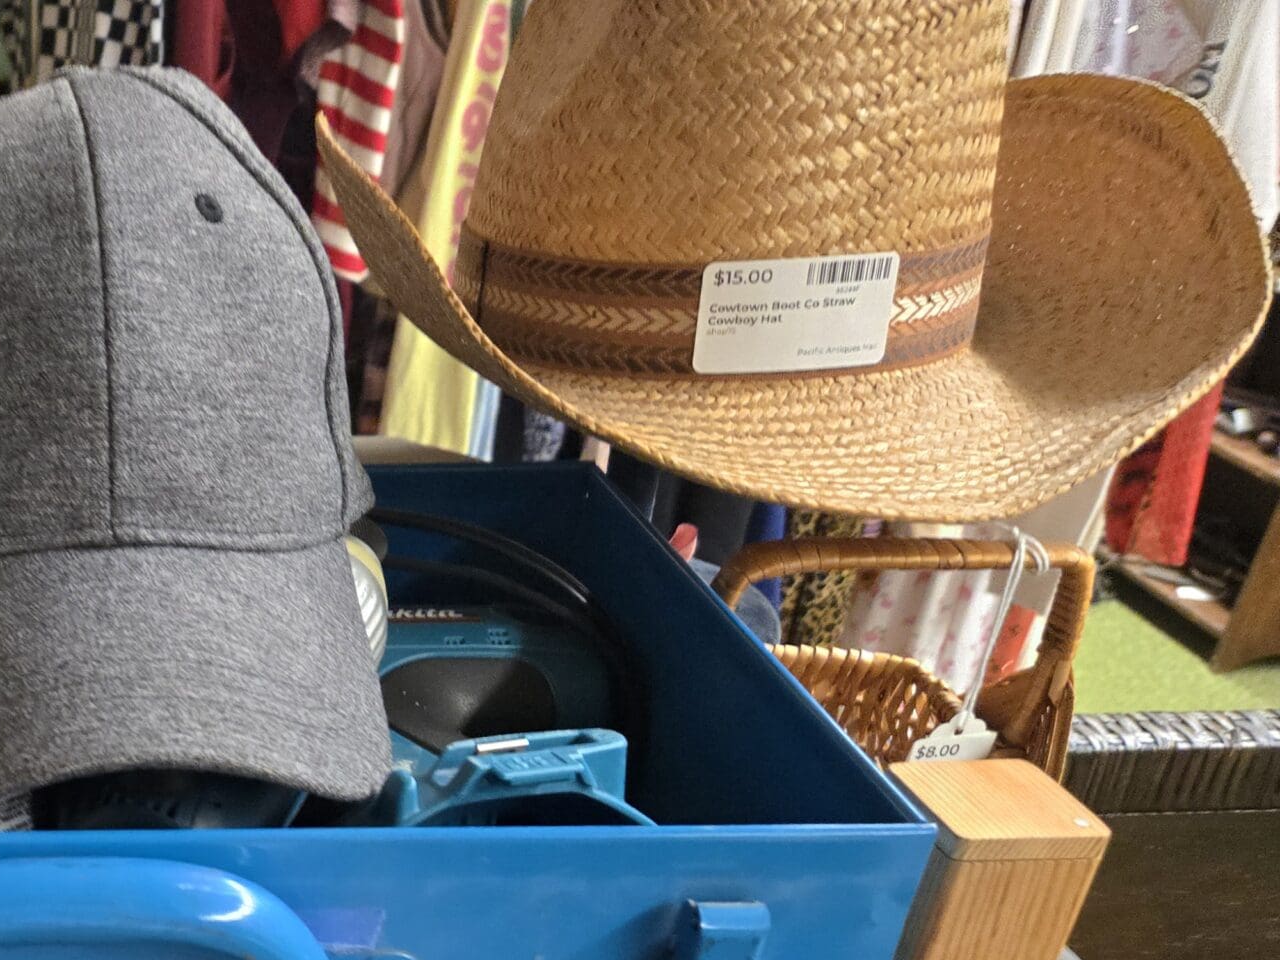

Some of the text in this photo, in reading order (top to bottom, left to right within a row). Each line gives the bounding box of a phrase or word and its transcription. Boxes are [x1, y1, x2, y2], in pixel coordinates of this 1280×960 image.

[713, 269, 773, 287] $15.00
[709, 296, 856, 314] Cowtown Boot Co Straw
[707, 313, 783, 327] Cowboy Hat
[915, 744, 960, 760] $8.00
